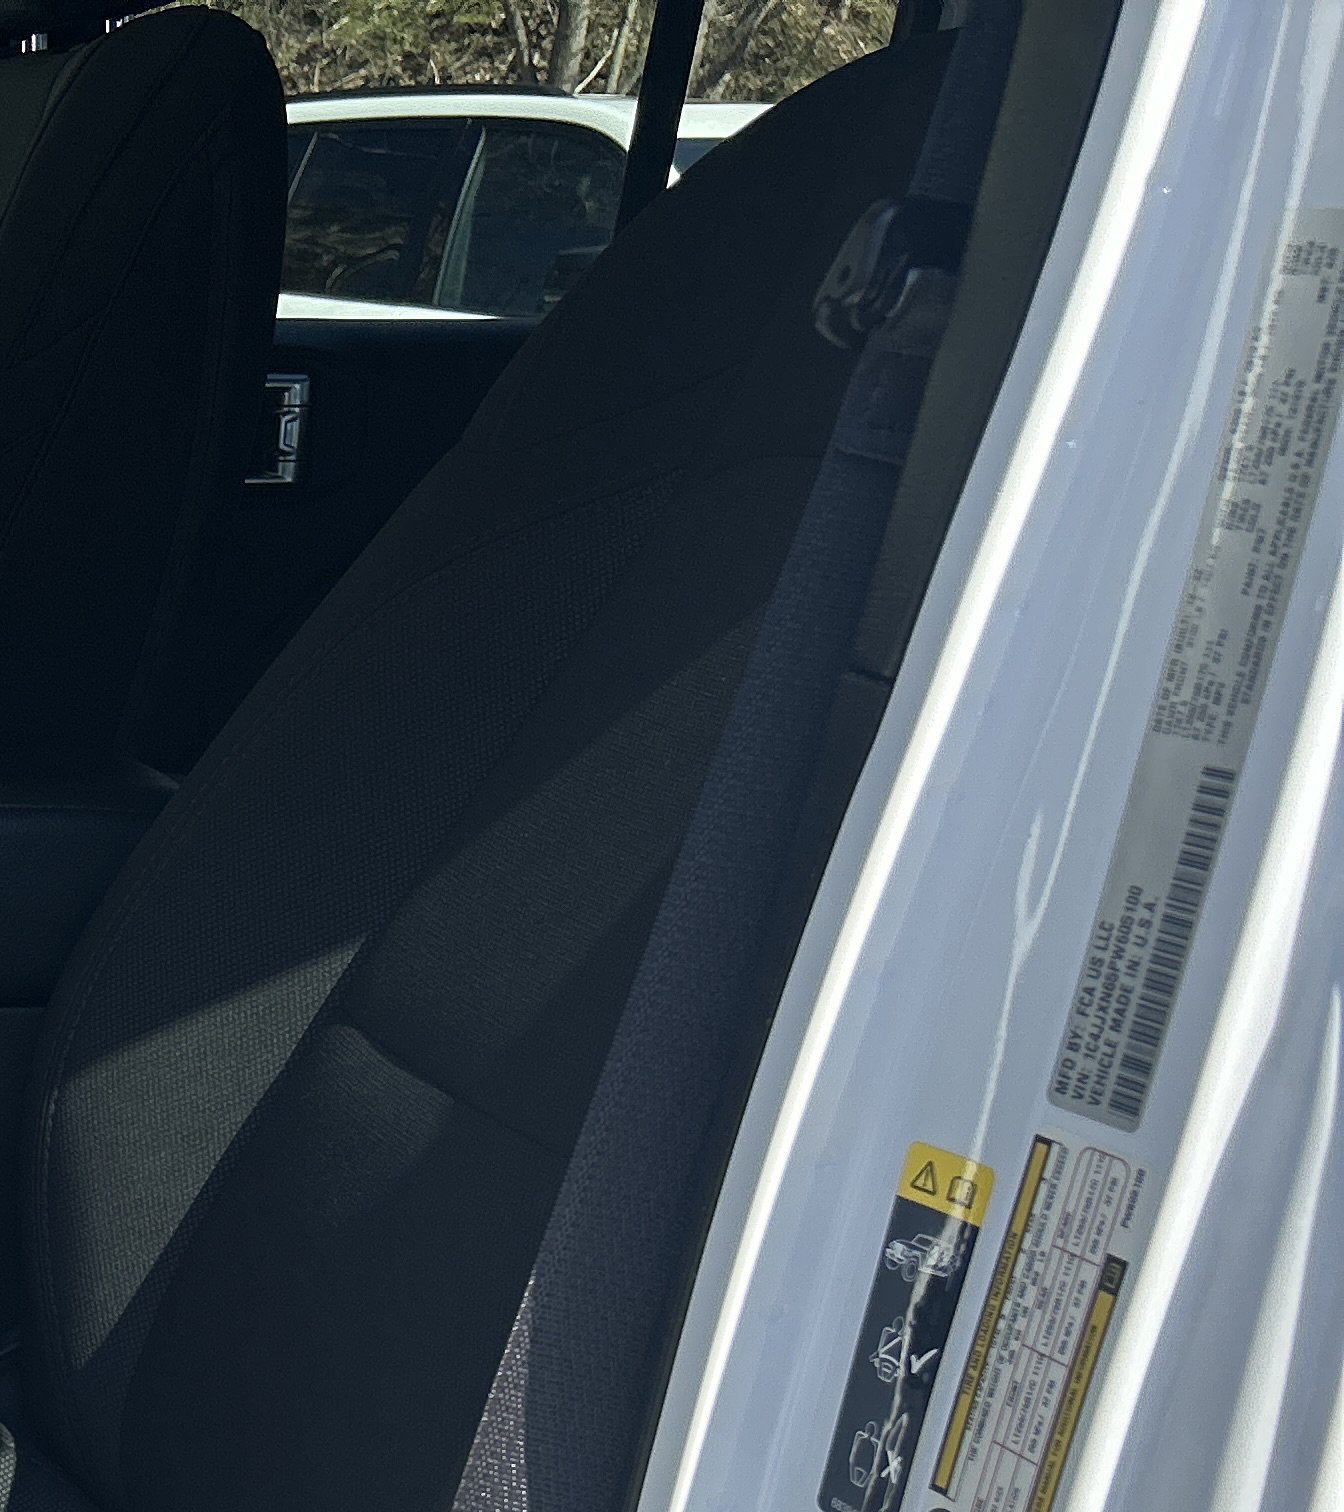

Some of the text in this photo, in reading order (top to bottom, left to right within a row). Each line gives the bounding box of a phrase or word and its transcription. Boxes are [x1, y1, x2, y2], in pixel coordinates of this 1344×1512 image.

[1054, 920, 1114, 1094] MFD BY: FCA US LLC
[1070, 1070, 1090, 1100] VIN:
[1086, 895, 1159, 1106] VEHICLE MADE IN: U.S.A.
